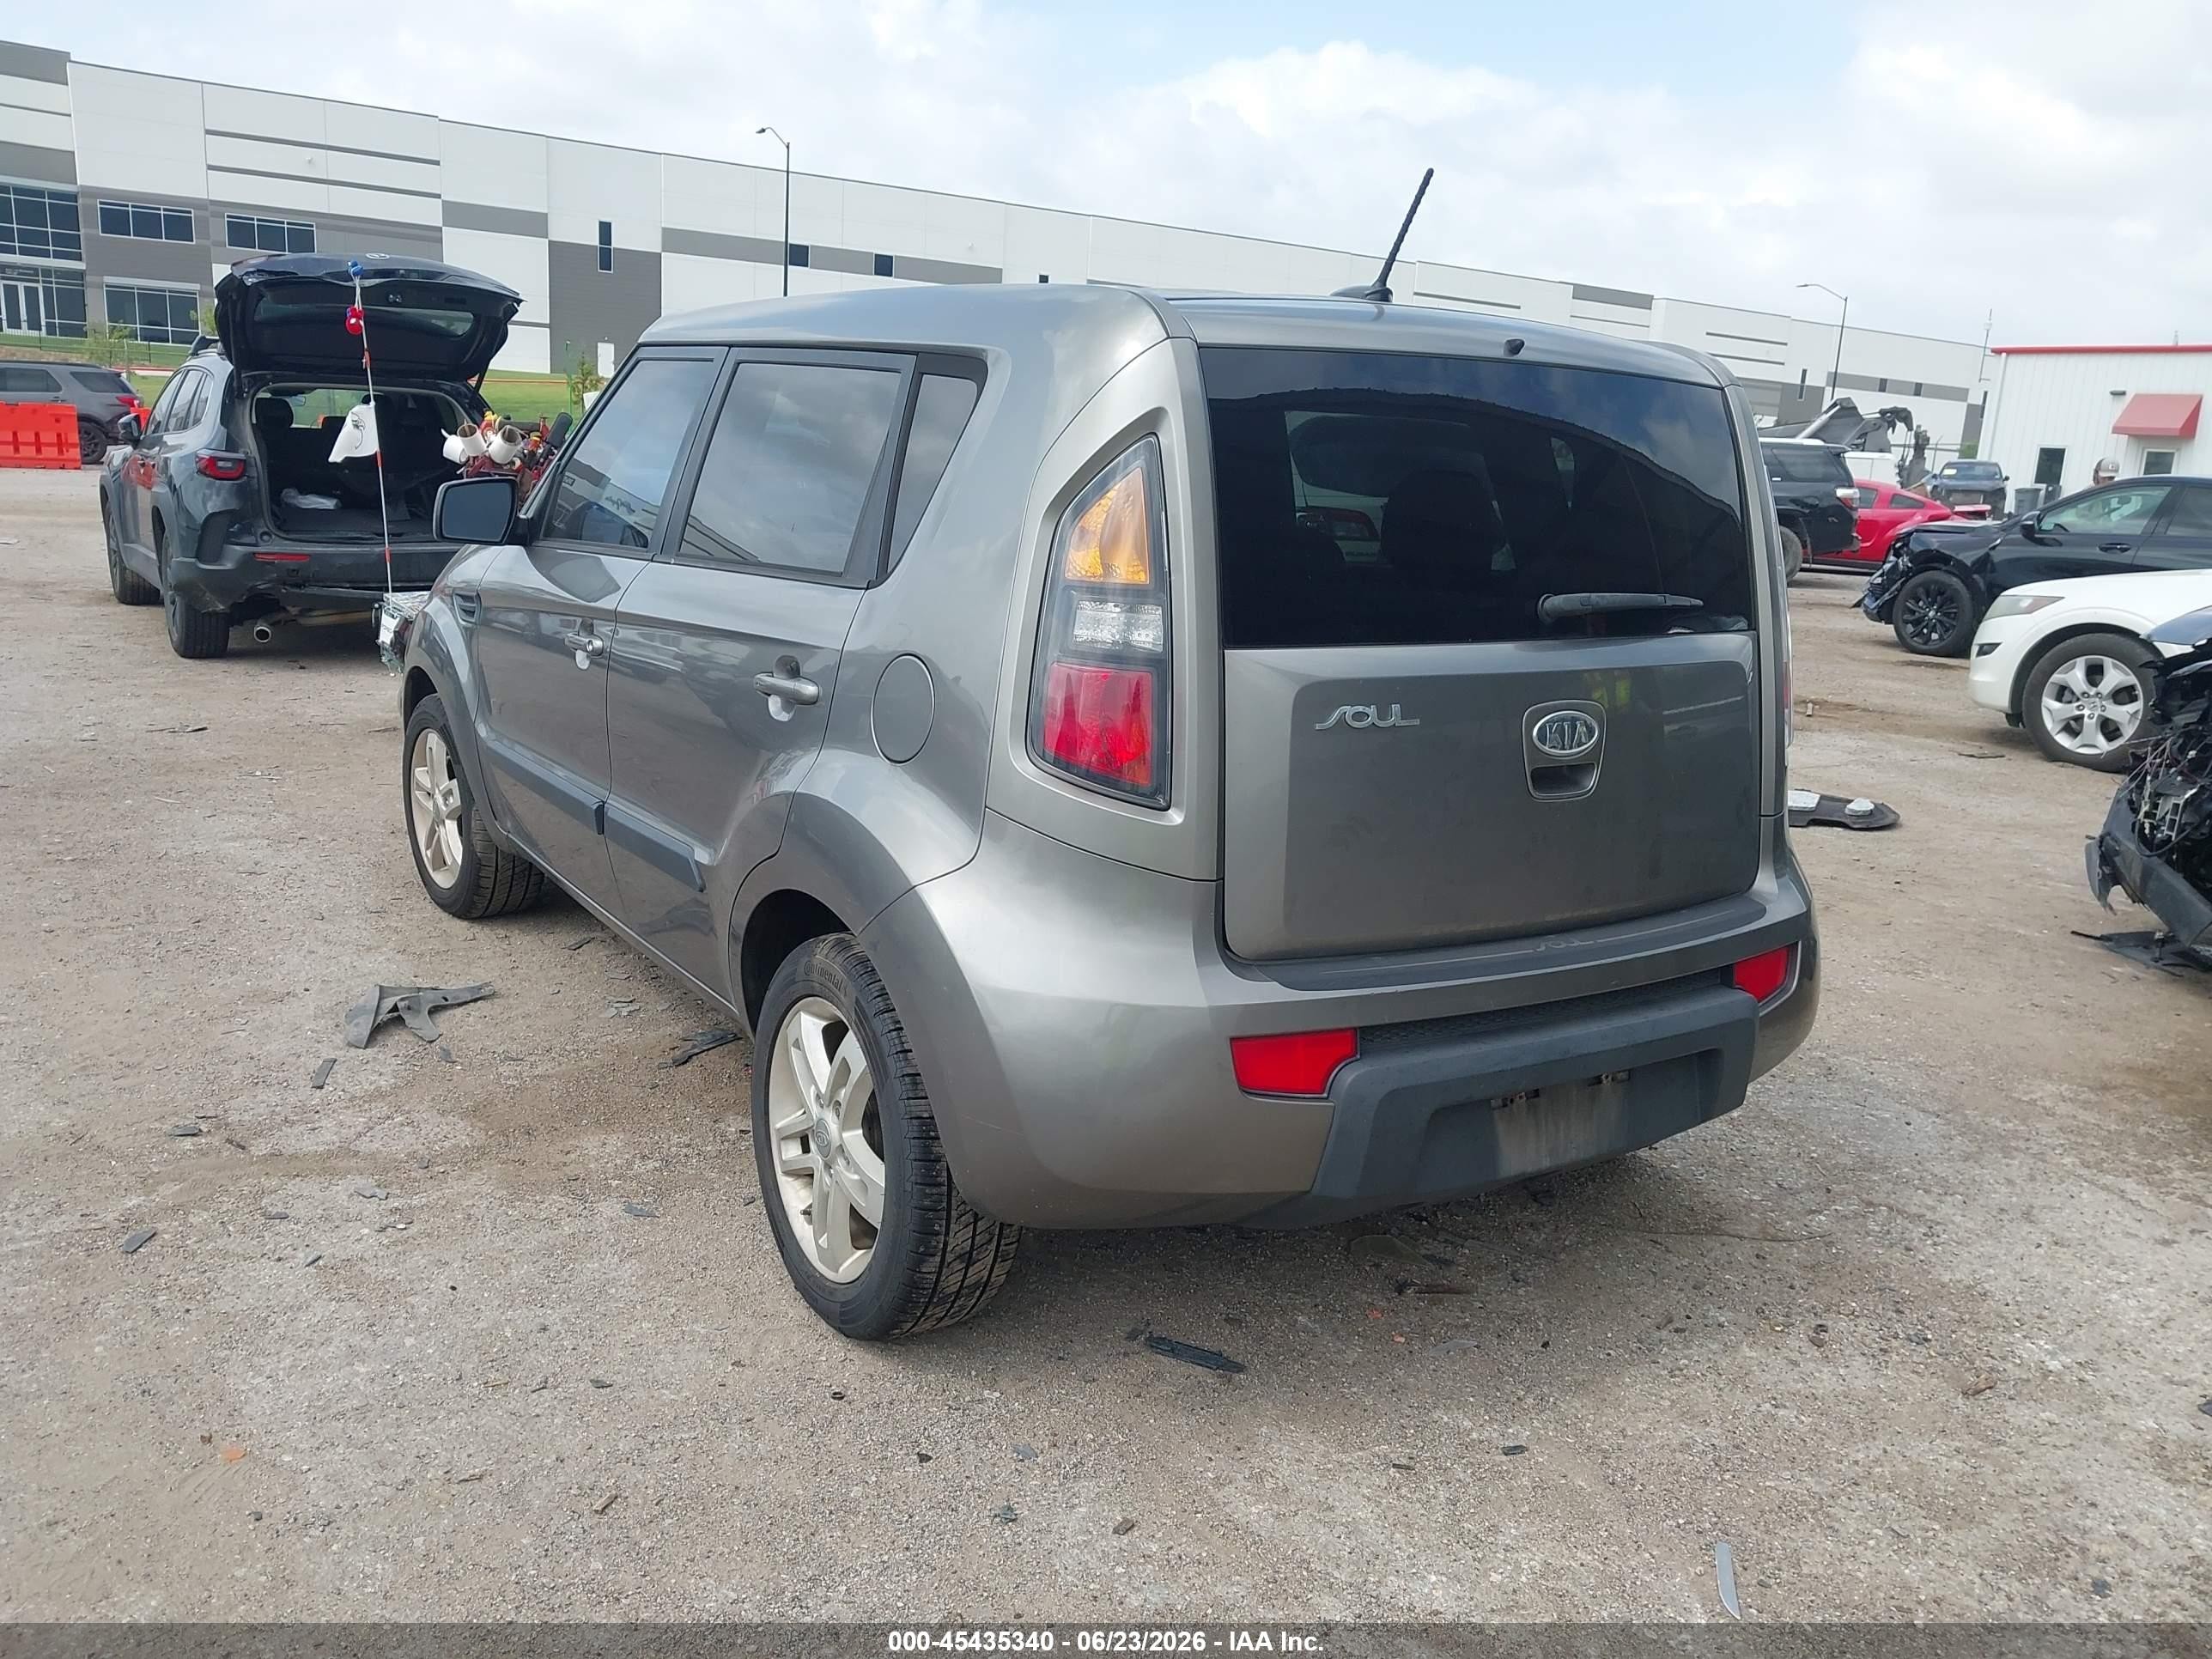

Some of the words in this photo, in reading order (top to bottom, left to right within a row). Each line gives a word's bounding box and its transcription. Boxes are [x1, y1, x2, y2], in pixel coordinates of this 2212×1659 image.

[1316, 704, 1419, 730] SOUL
[1546, 720, 1589, 750] KIA
[804, 961, 843, 992] Continental
